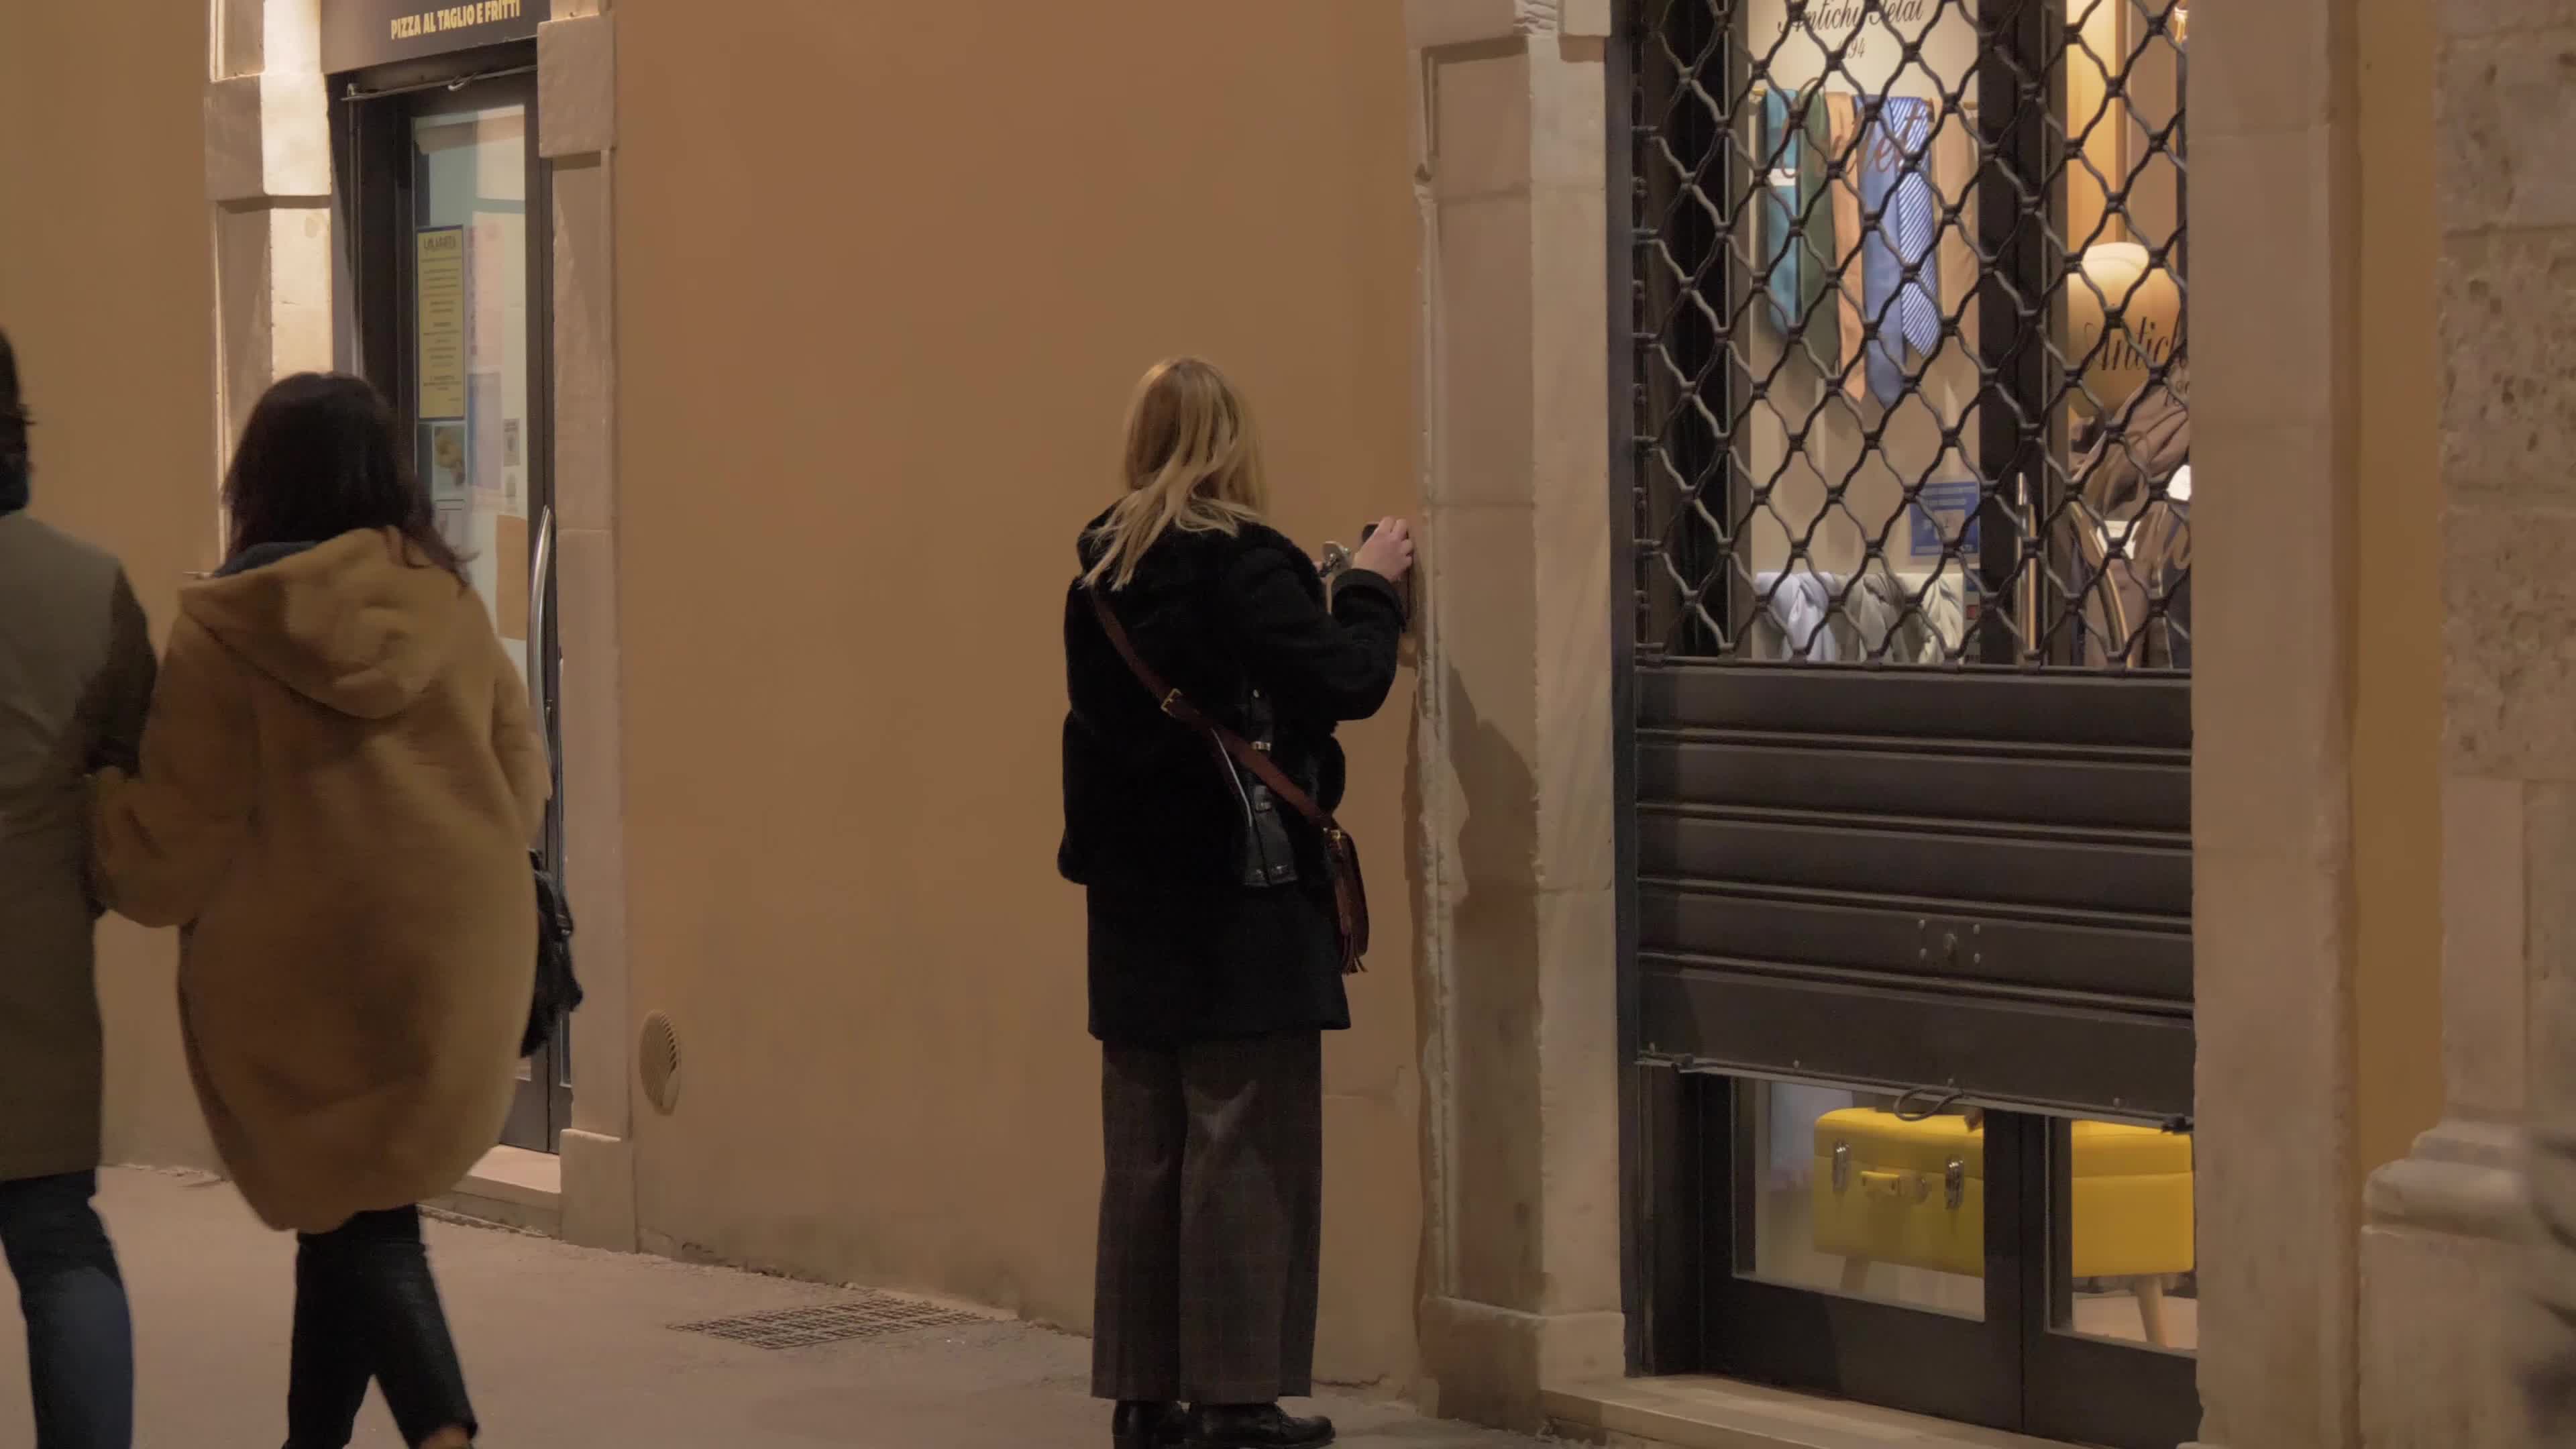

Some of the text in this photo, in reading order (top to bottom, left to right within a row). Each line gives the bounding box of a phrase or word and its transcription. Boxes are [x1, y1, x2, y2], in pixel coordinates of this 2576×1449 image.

[390, 0, 521, 40] PIZZA AL TAGLIO E FRITTI
